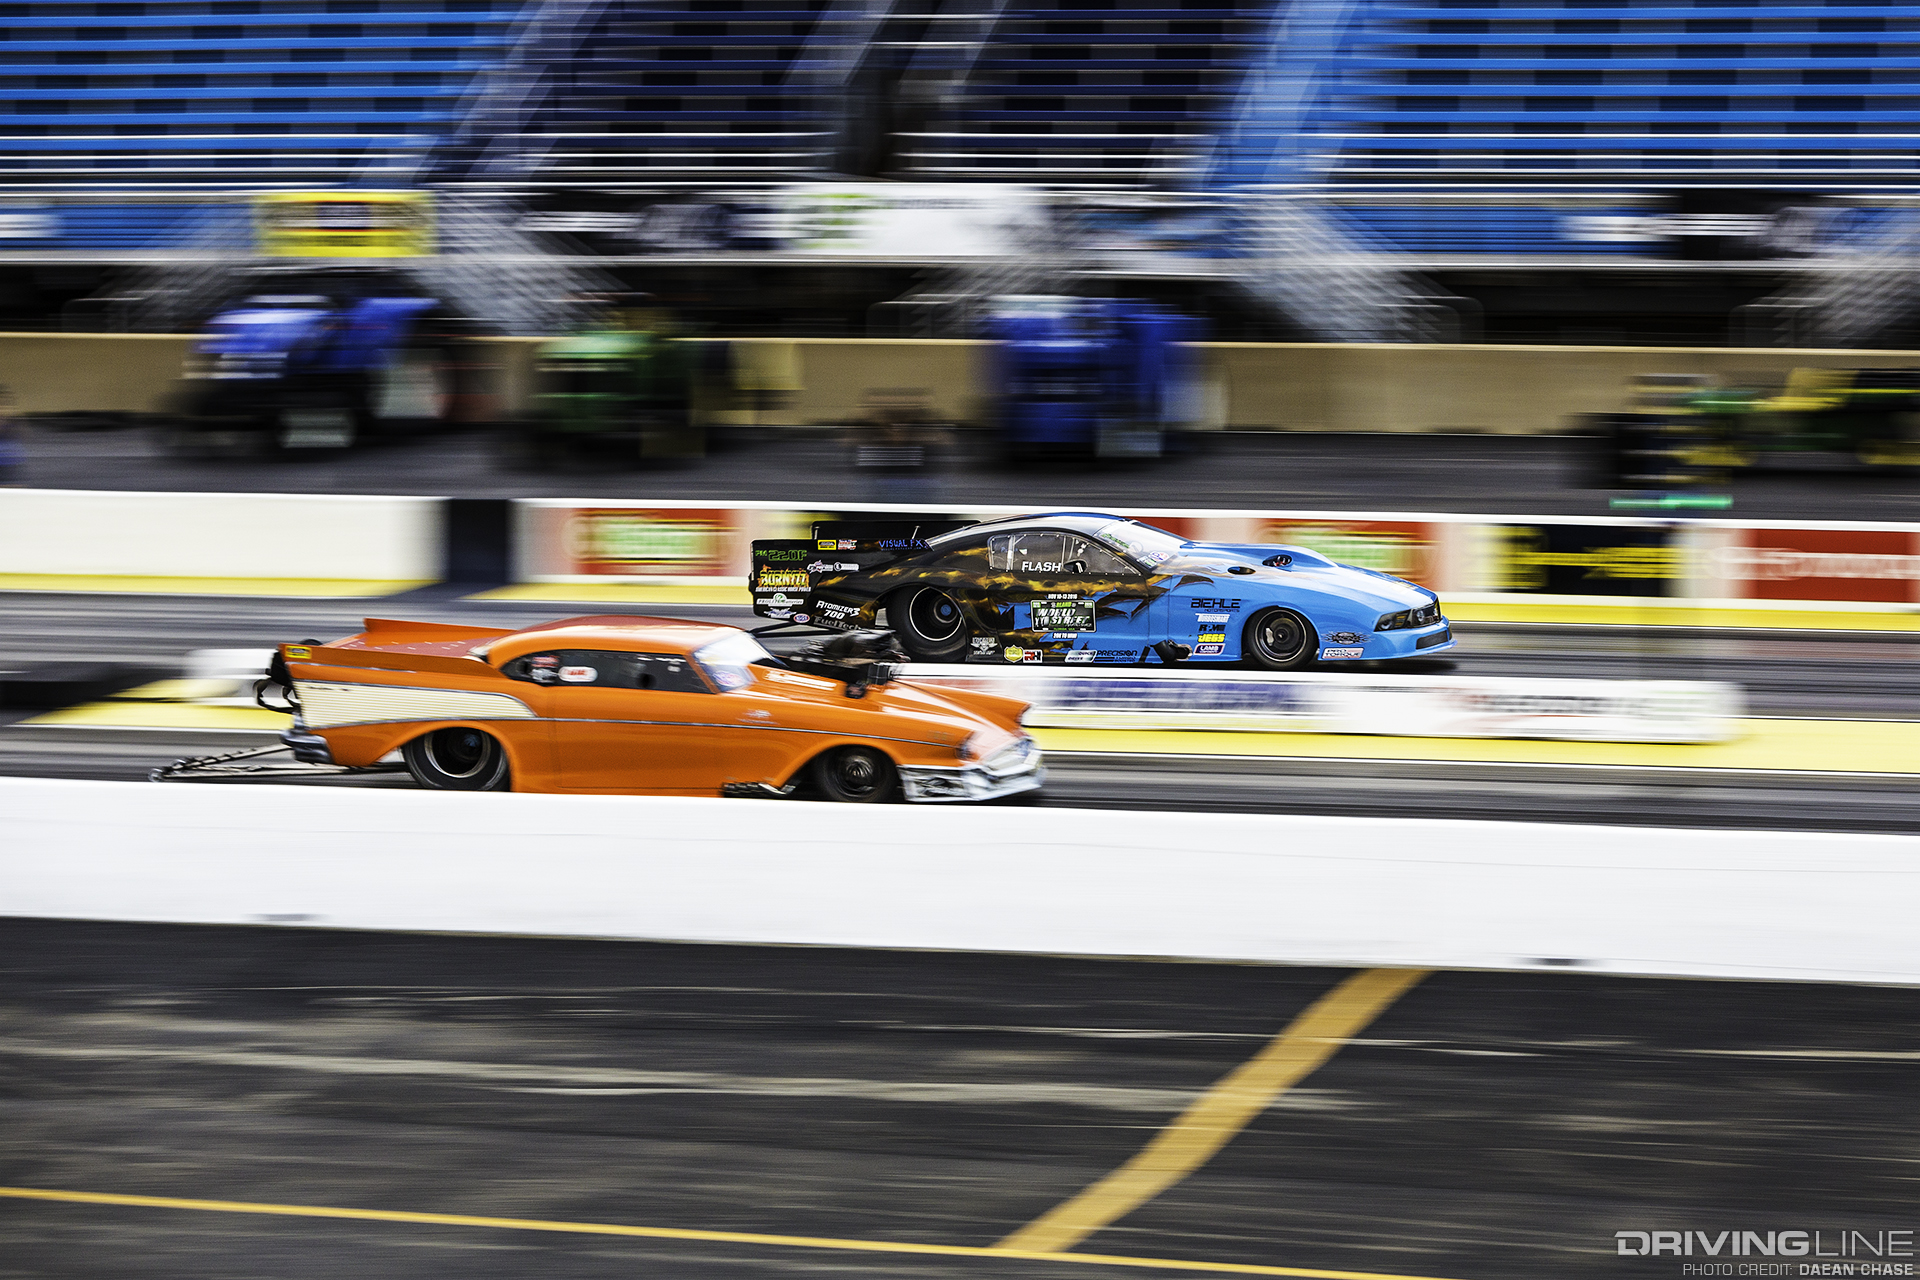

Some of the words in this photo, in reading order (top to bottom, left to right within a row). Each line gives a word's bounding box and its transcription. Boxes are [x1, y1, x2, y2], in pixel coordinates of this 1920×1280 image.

[879, 539, 907, 548] VISUAL
[910, 539, 924, 548] FX
[1022, 561, 1062, 571] FLASH
[1191, 598, 1241, 608] BIEHLE
[824, 609, 845, 619] 700
[1037, 608, 1076, 617] WORLD
[814, 616, 862, 631] FuelTech
[1051, 616, 1090, 624] STREET
[1198, 633, 1225, 643] JEGS
